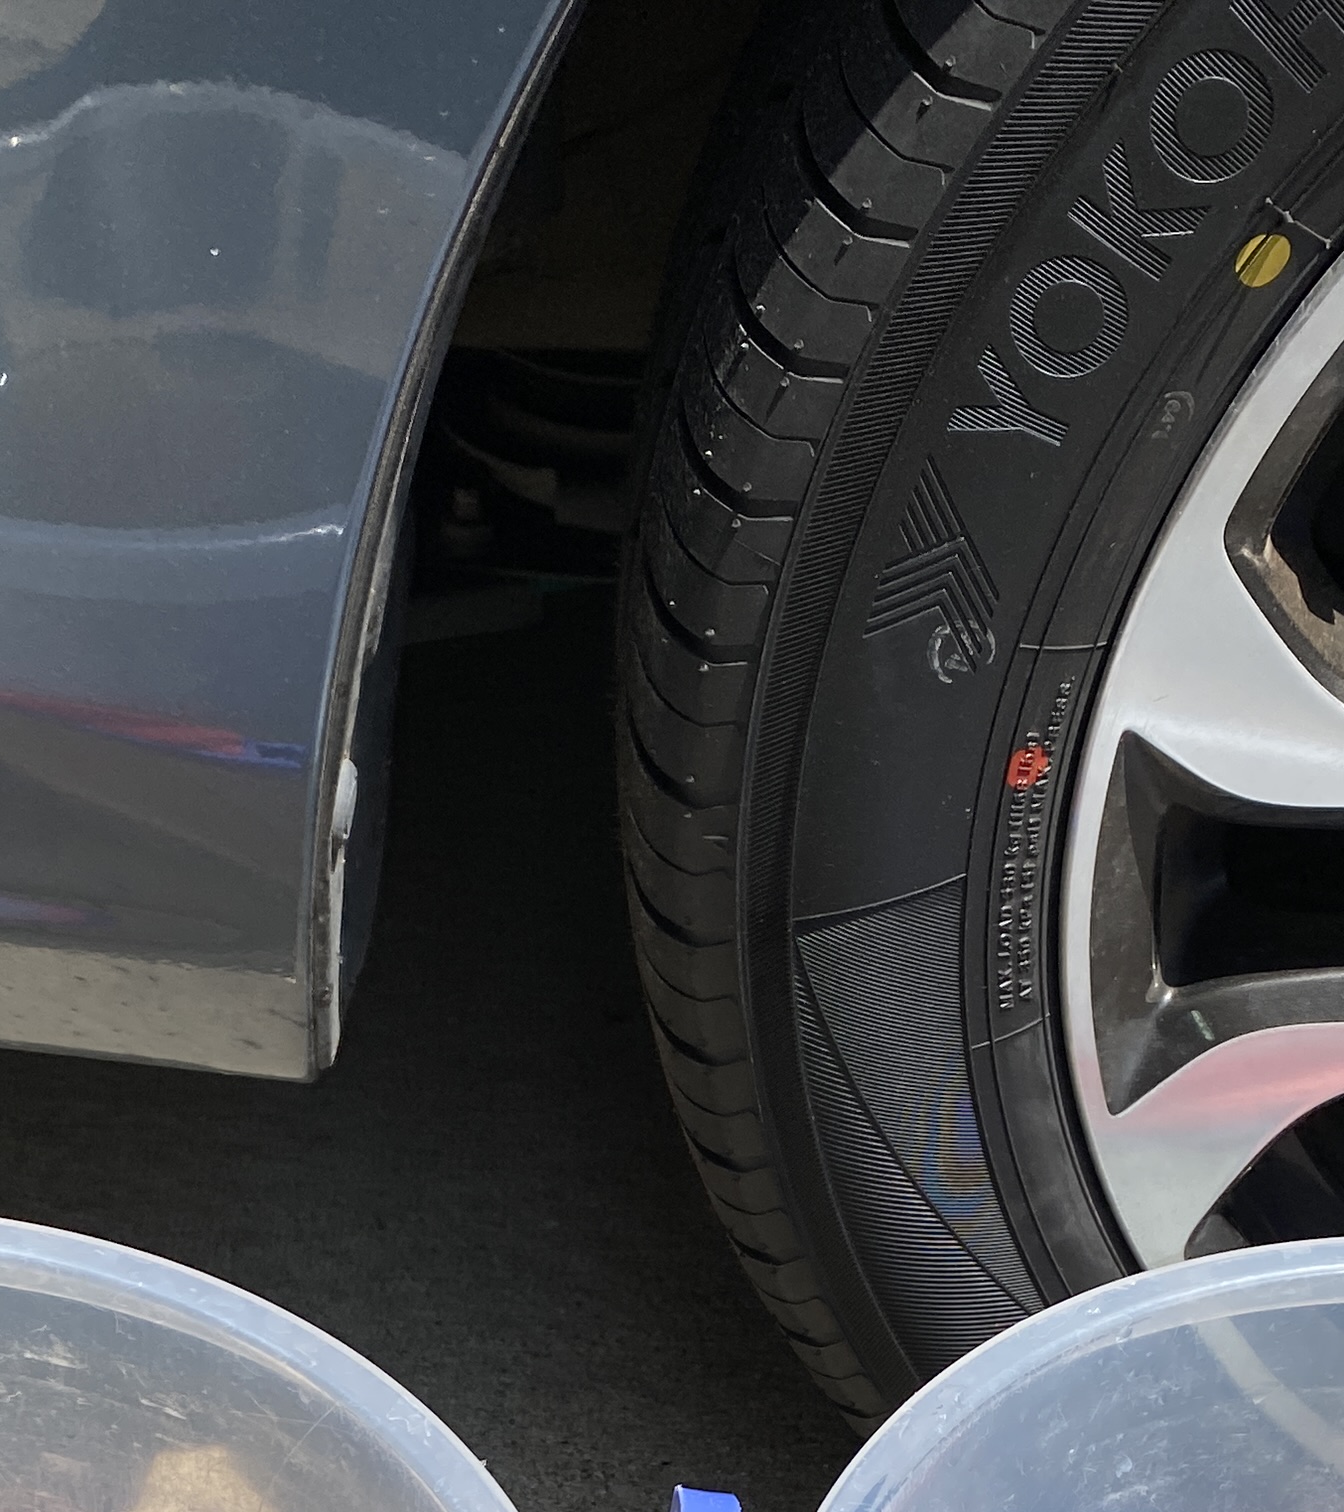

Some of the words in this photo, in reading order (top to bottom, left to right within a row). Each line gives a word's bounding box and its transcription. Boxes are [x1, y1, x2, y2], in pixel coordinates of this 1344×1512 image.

[997, 904, 1014, 957] LOAD
[997, 961, 1014, 1009] MAX.
[1017, 978, 1033, 998] AT
